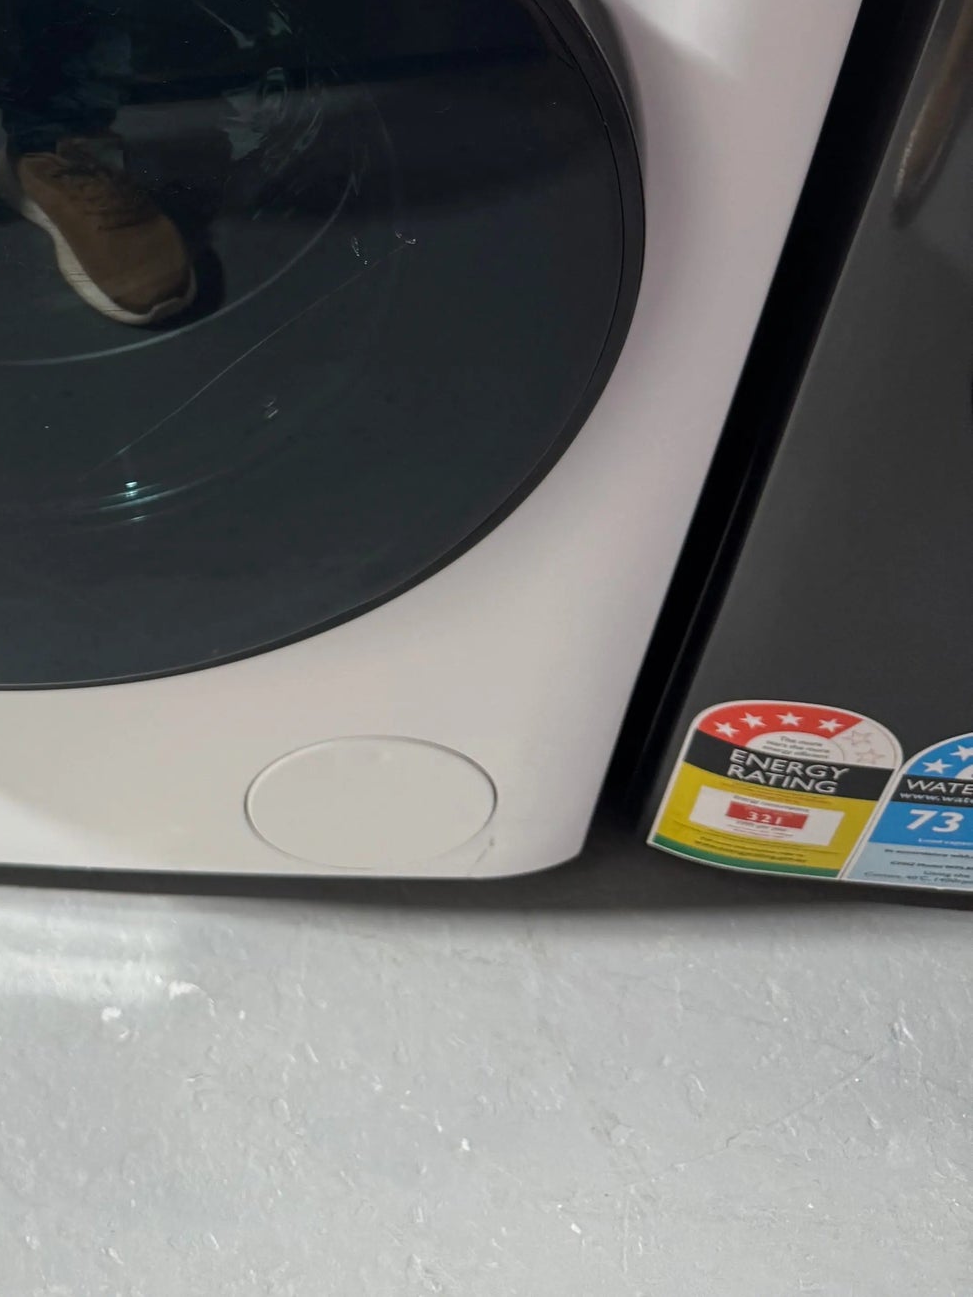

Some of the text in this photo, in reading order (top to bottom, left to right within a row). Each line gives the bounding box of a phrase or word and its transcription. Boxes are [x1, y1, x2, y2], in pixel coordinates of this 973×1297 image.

[729, 749, 850, 780] ENERGY
[727, 764, 839, 794] RATING
[907, 778, 973, 795] WATE
[899, 792, 973, 805] www.wate
[746, 810, 783, 825] 321
[905, 808, 965, 833] 73
